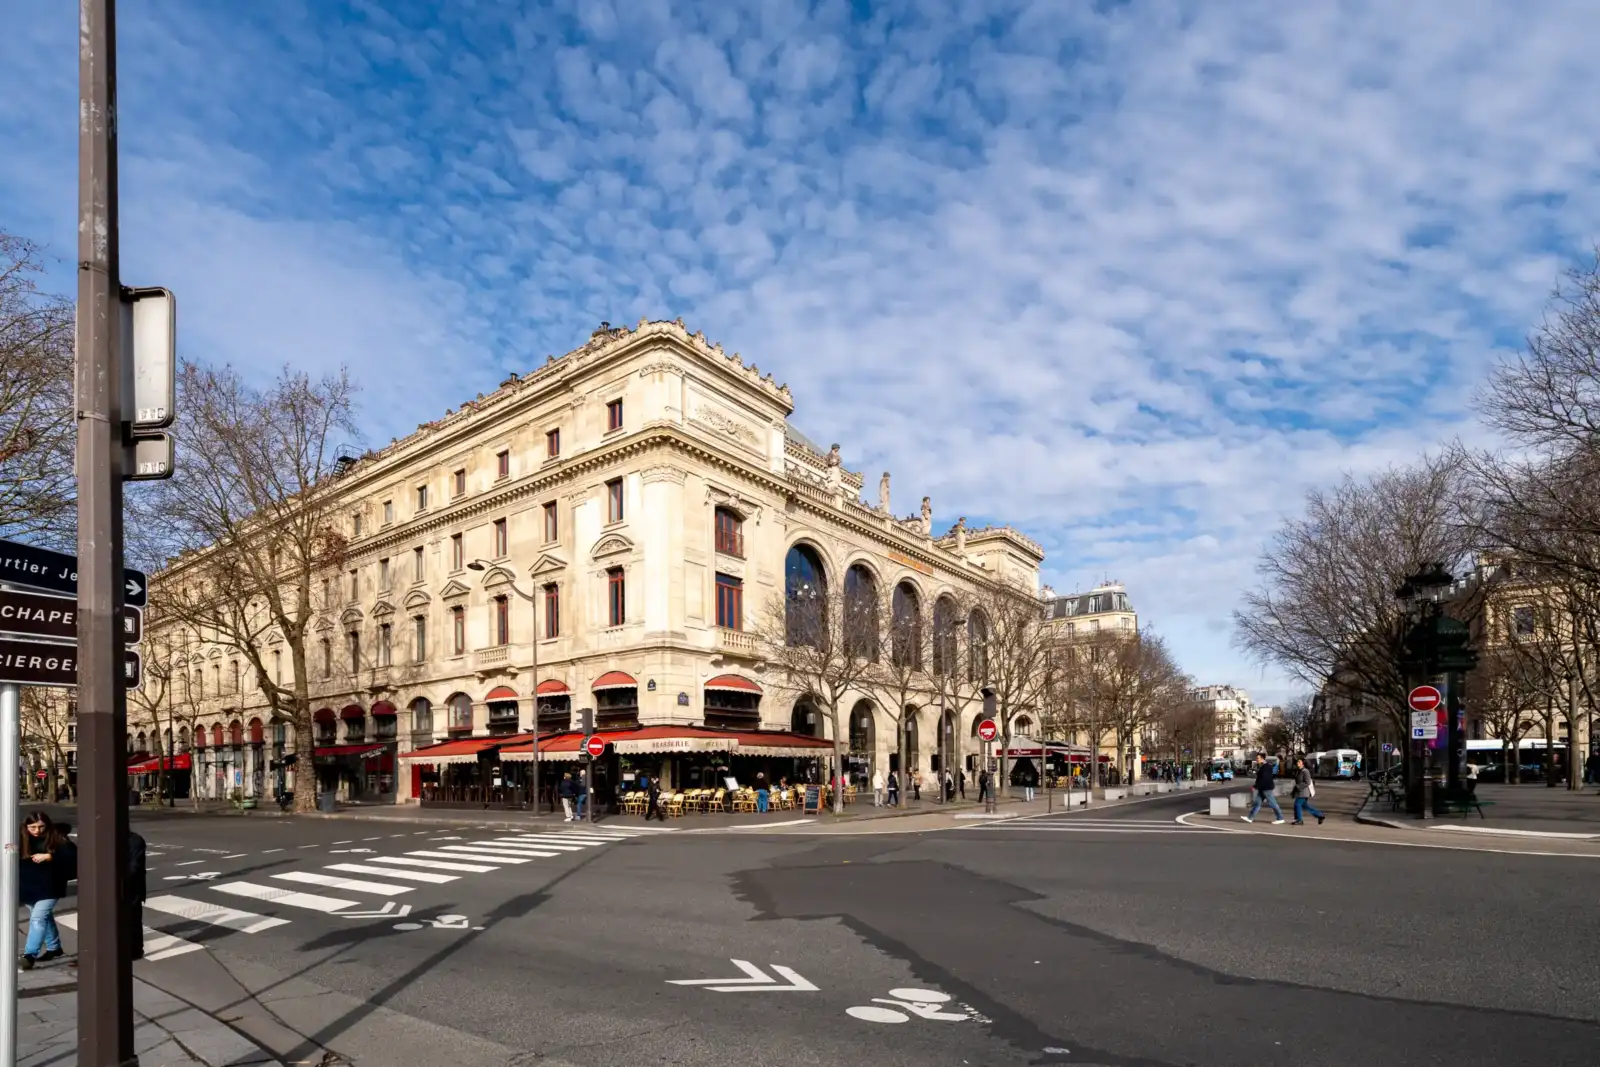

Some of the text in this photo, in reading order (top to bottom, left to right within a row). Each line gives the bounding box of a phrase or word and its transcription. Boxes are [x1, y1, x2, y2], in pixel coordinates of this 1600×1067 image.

[0, 556, 49, 575] rtier
[1, 605, 78, 625] CHAPE
[0, 653, 78, 671] IERGE
